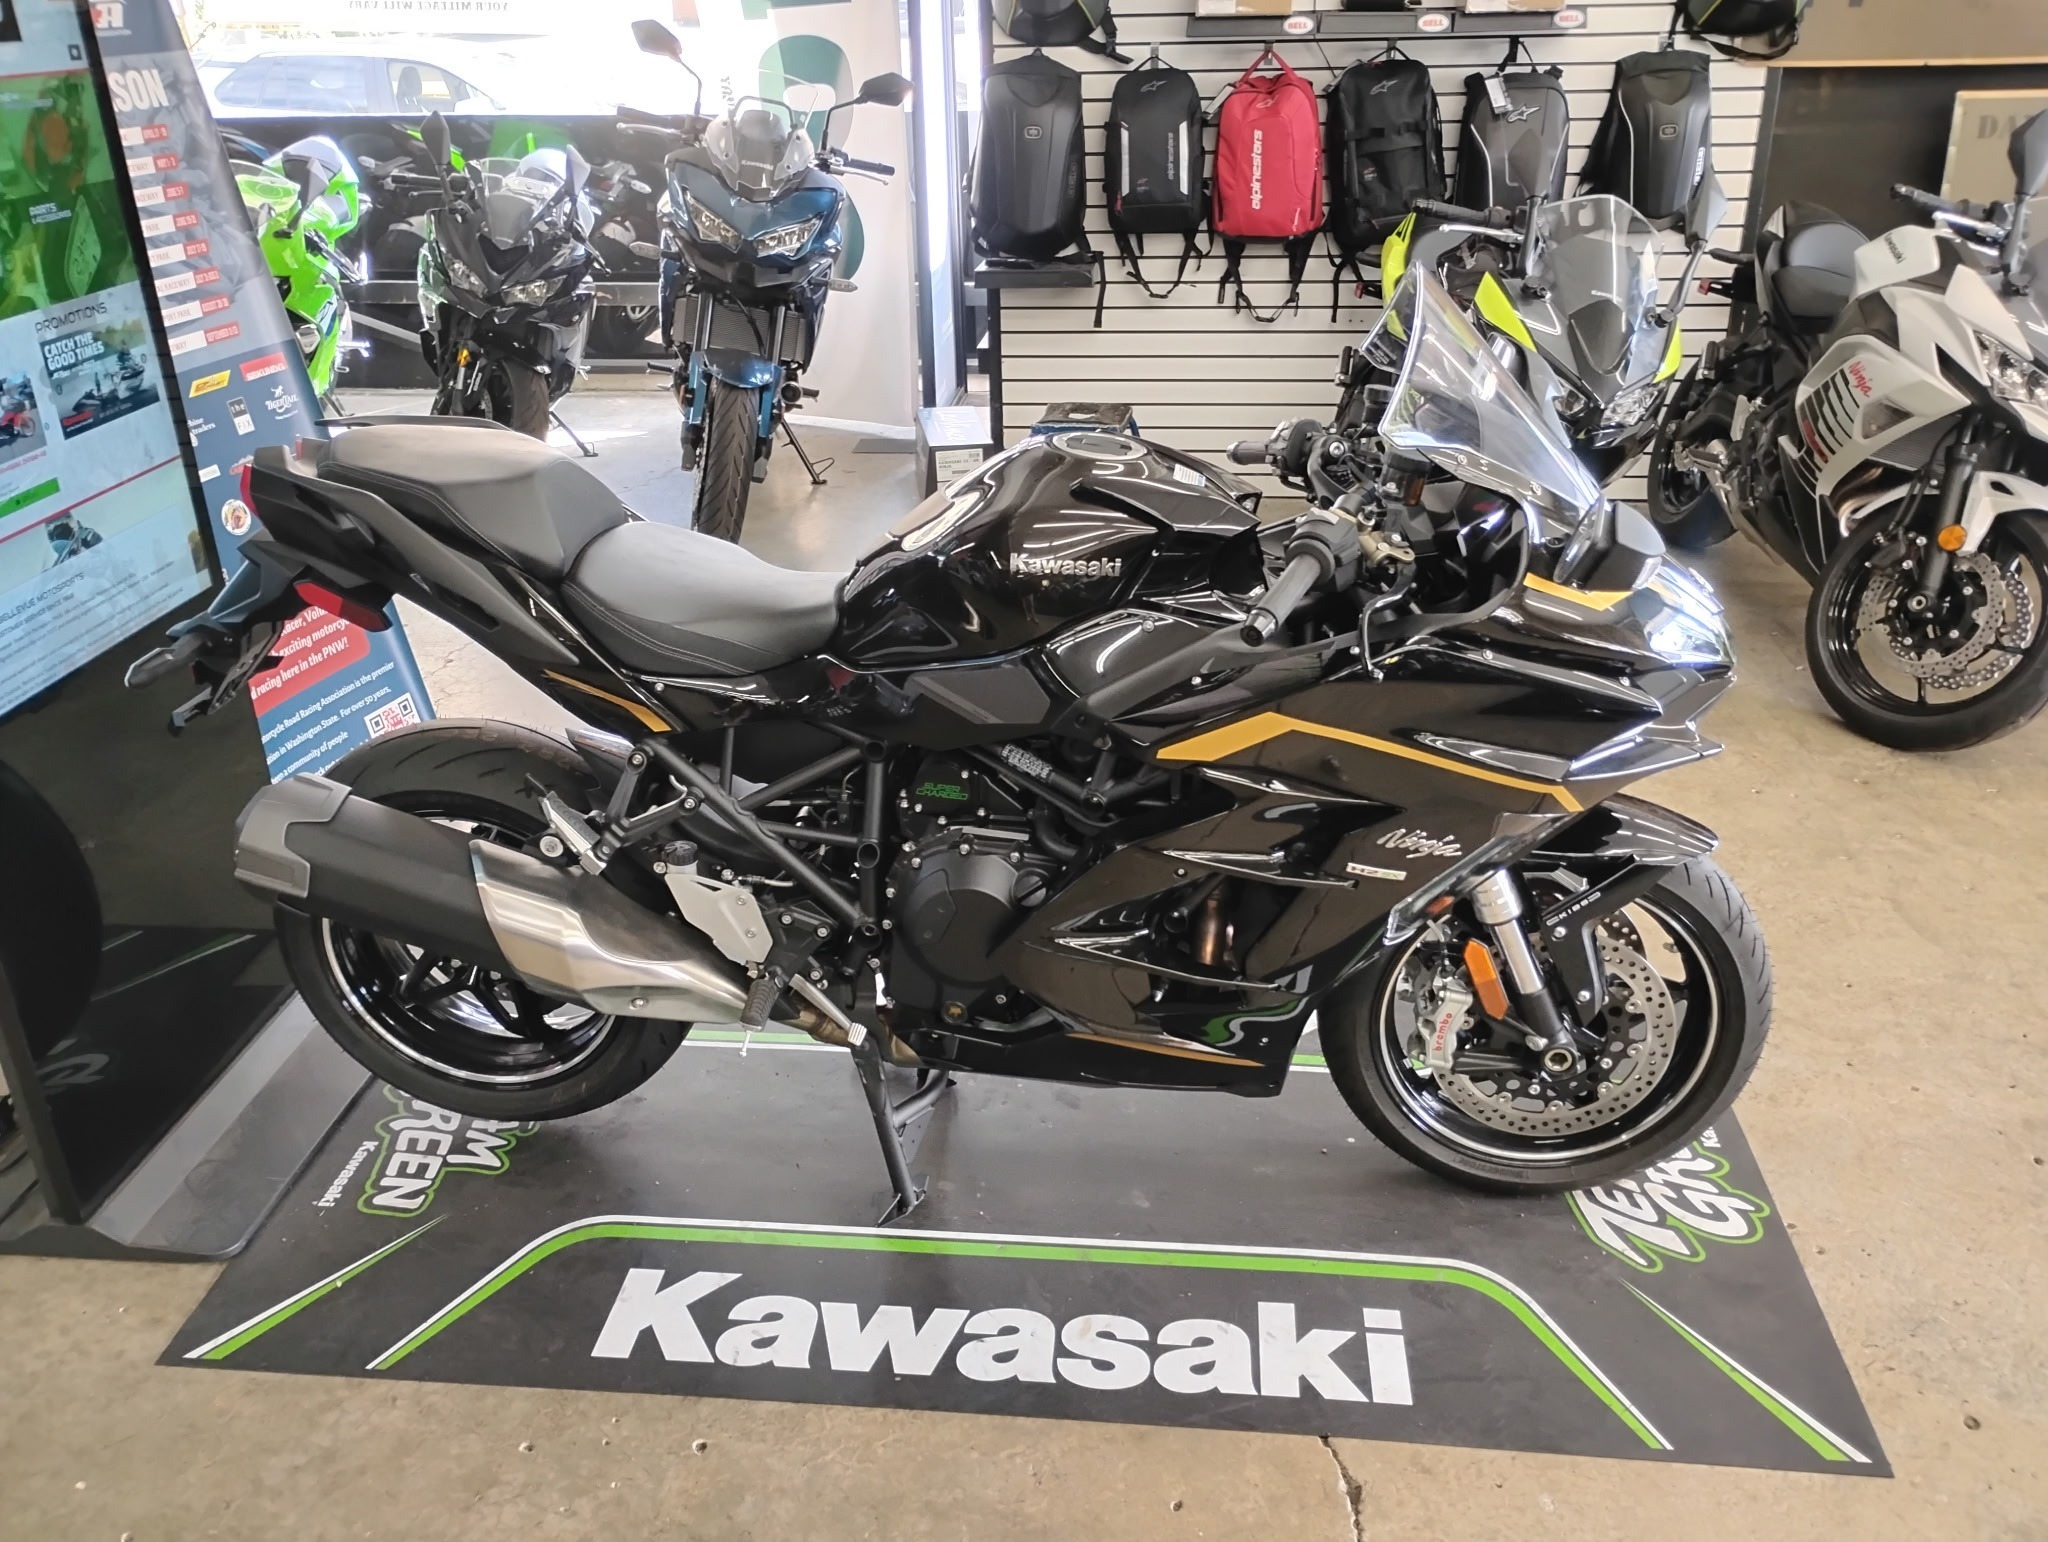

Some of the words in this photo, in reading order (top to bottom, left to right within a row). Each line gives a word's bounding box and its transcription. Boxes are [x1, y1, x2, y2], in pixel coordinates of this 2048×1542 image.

[108, 68, 169, 112] SON
[1250, 128, 1263, 210] alpinestars
[34, 302, 107, 334] PROMOTIONS
[44, 337, 75, 358] CATCH
[74, 332, 94, 347] THE
[47, 351, 76, 371] GOOD
[75, 341, 105, 361] TIMES
[1848, 360, 1872, 398] Ninja
[231, 403, 245, 414] the
[1010, 552, 1122, 577] Kawasaki
[283, 633, 313, 658] exciting
[256, 674, 283, 697] racing
[280, 662, 301, 681] here
[308, 650, 324, 667] the
[322, 636, 349, 661] PNW!
[283, 715, 301, 731] Road
[299, 704, 322, 723] Racing
[320, 683, 356, 711] Association
[360, 674, 373, 688] the
[371, 661, 395, 683] premier
[284, 726, 323, 755] Washington
[320, 715, 341, 732] State.
[339, 706, 352, 718] For
[350, 700, 365, 713] over
[287, 746, 322, 775] community
[326, 730, 349, 751] people
[915, 788, 968, 801] CHARGED
[922, 783, 961, 793] SUPER
[1376, 828, 1463, 859] Ninja
[1432, 1012, 1453, 1052] brembo
[372, 1098, 462, 1210] REEN
[316, 1140, 380, 1208] Kawasaki
[589, 1267, 1414, 1406] Kawasaki
